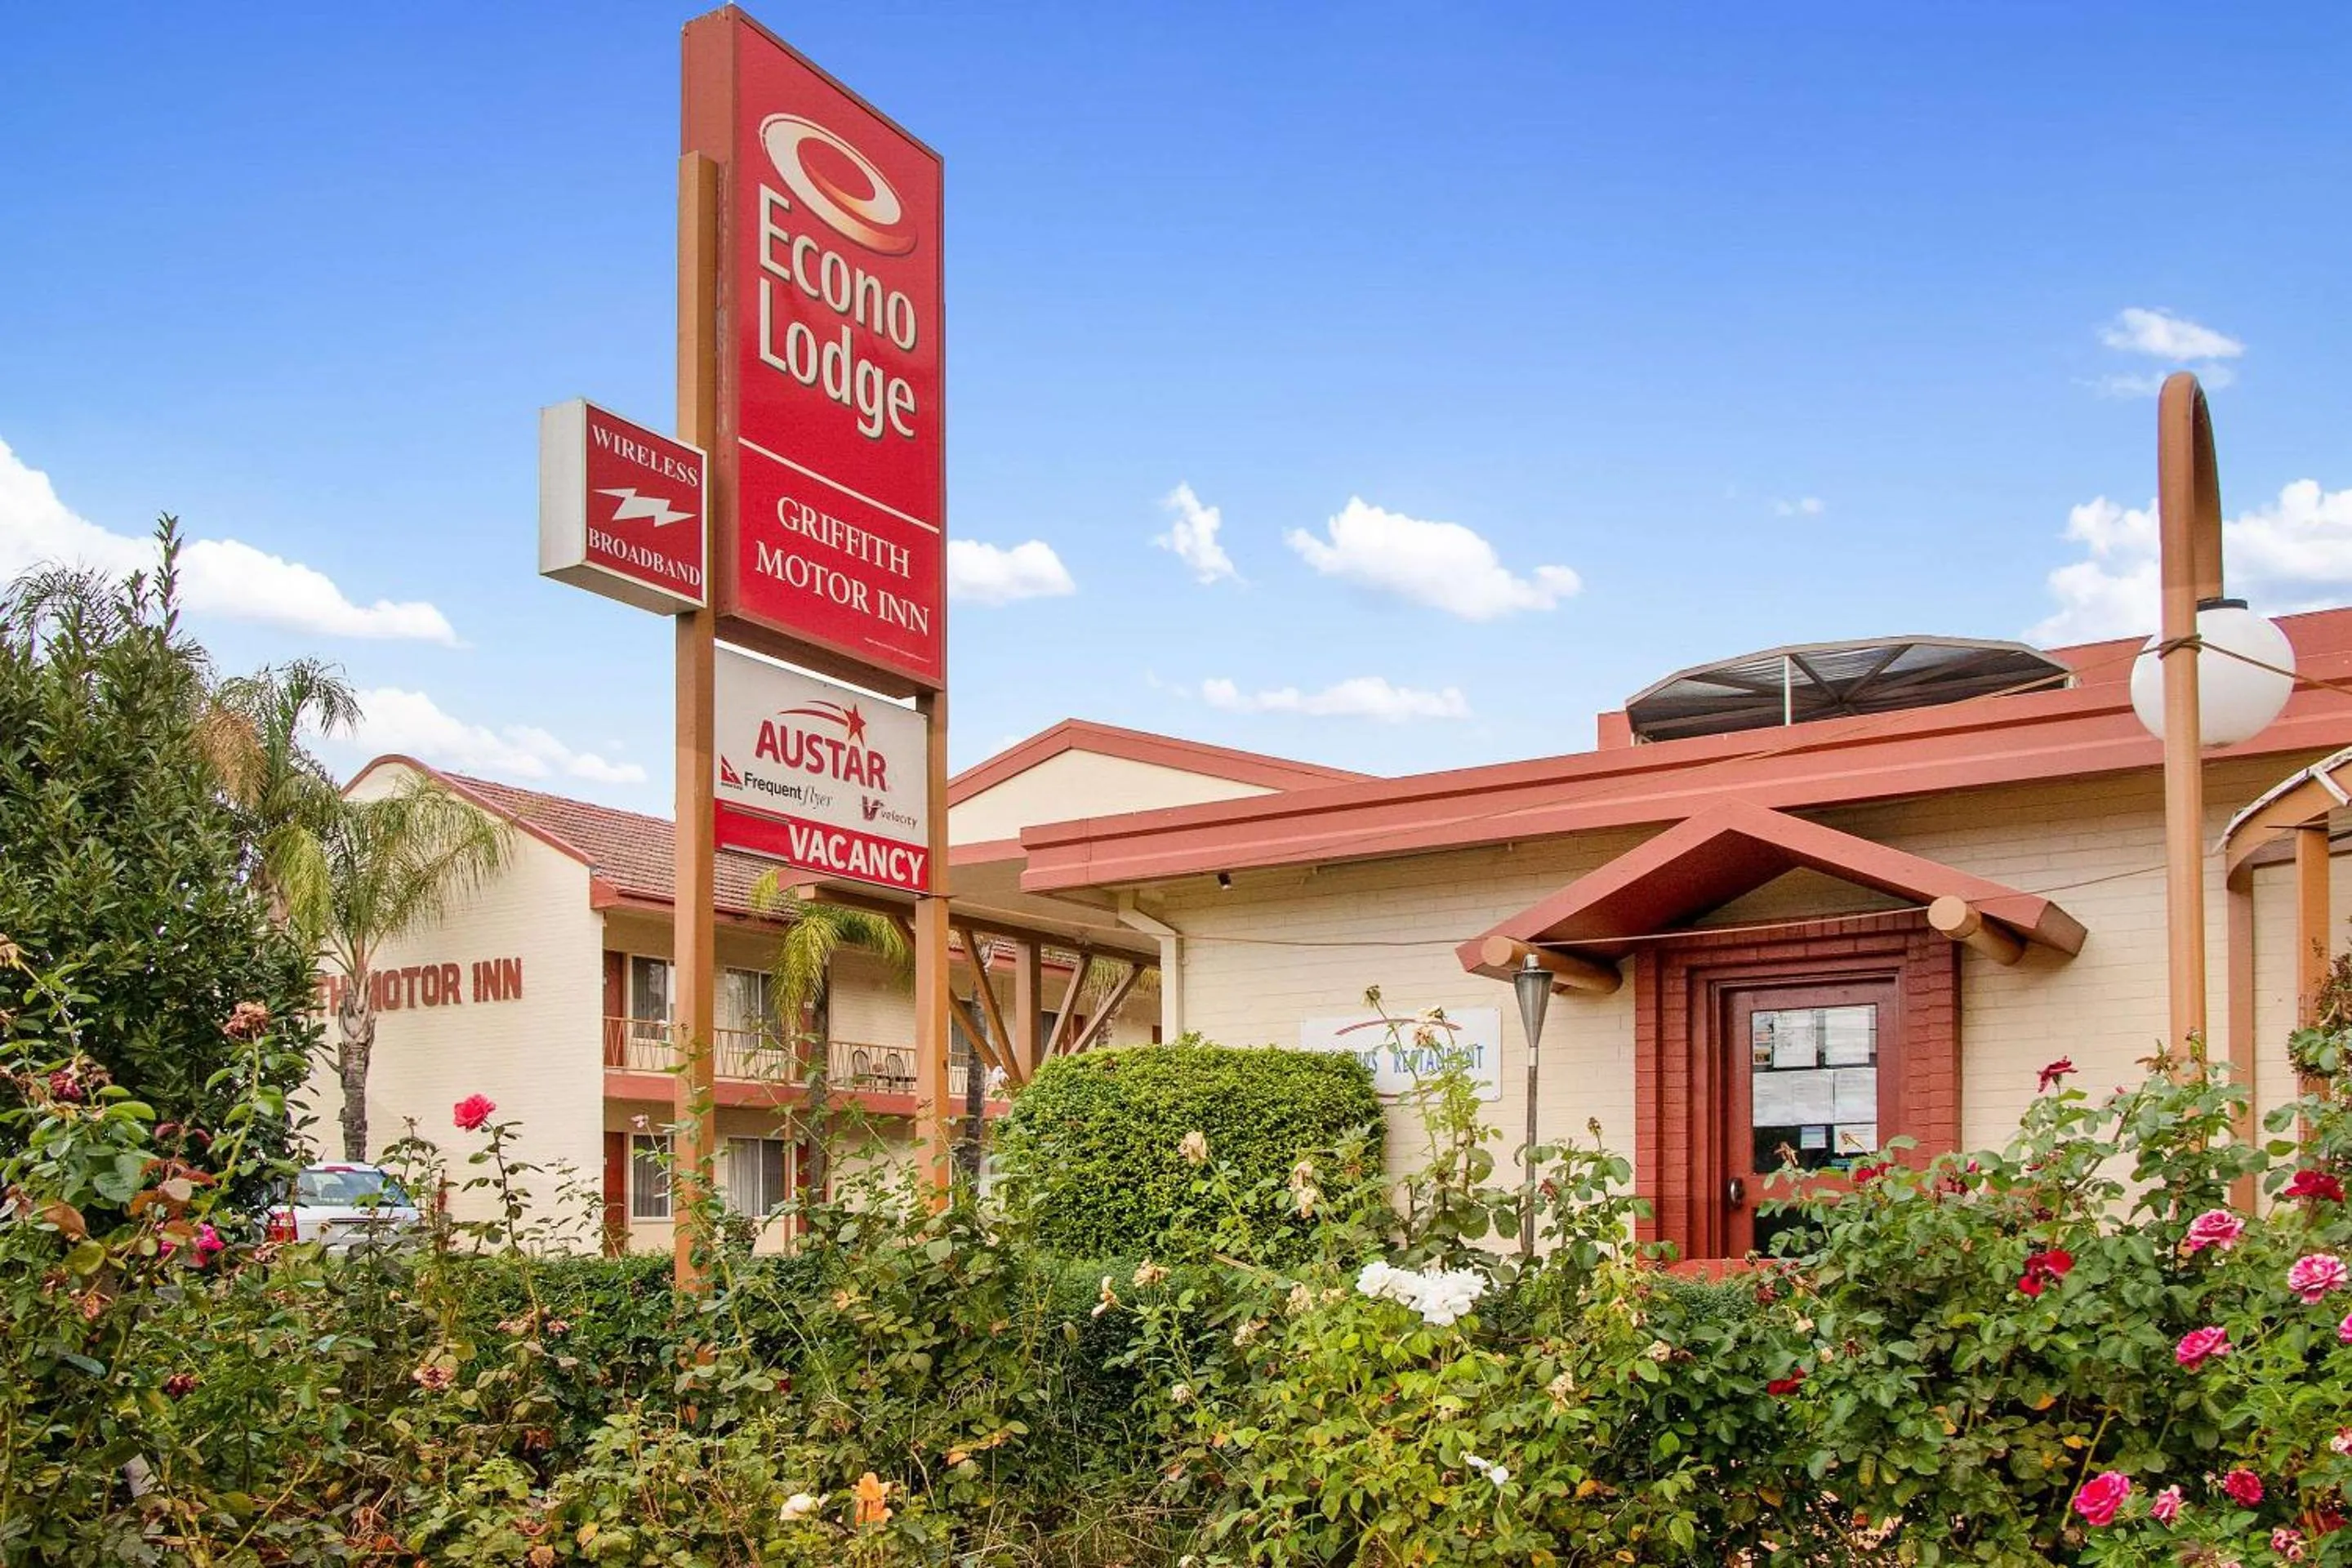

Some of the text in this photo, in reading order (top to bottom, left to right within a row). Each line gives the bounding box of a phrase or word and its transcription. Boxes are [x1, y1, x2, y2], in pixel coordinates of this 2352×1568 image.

[759, 182, 916, 350] Econo
[759, 277, 916, 439] Lodge
[591, 424, 699, 488] WIRELESS
[588, 526, 702, 587] BROADBAND
[777, 496, 911, 579] GRIFFITH
[755, 541, 929, 637] MOTOR INN
[744, 771, 802, 800] Frequent
[755, 719, 889, 792] AUSTAR
[787, 824, 925, 885] VACANCY
[471, 957, 523, 1003] INN
